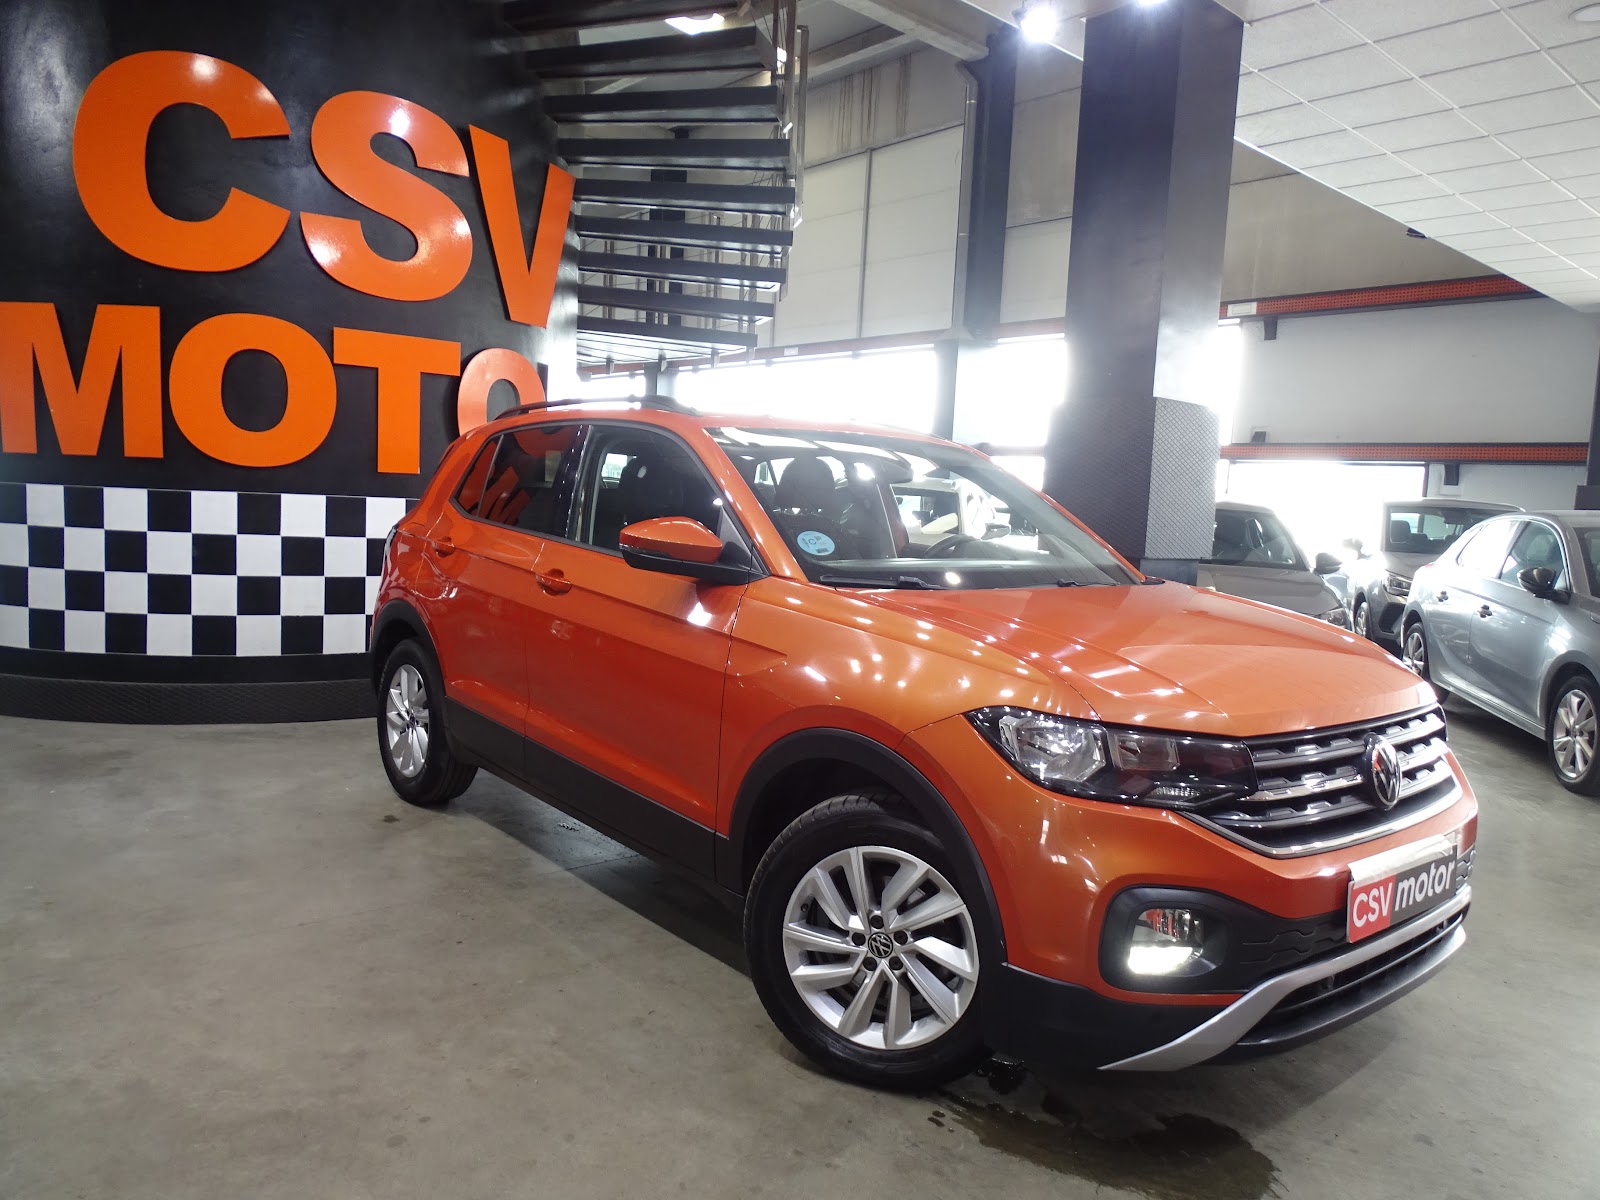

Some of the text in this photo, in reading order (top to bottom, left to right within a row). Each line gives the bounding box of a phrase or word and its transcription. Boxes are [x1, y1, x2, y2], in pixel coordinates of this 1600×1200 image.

[73, 50, 575, 328] CSV
[1352, 860, 1456, 928] CSV motor
